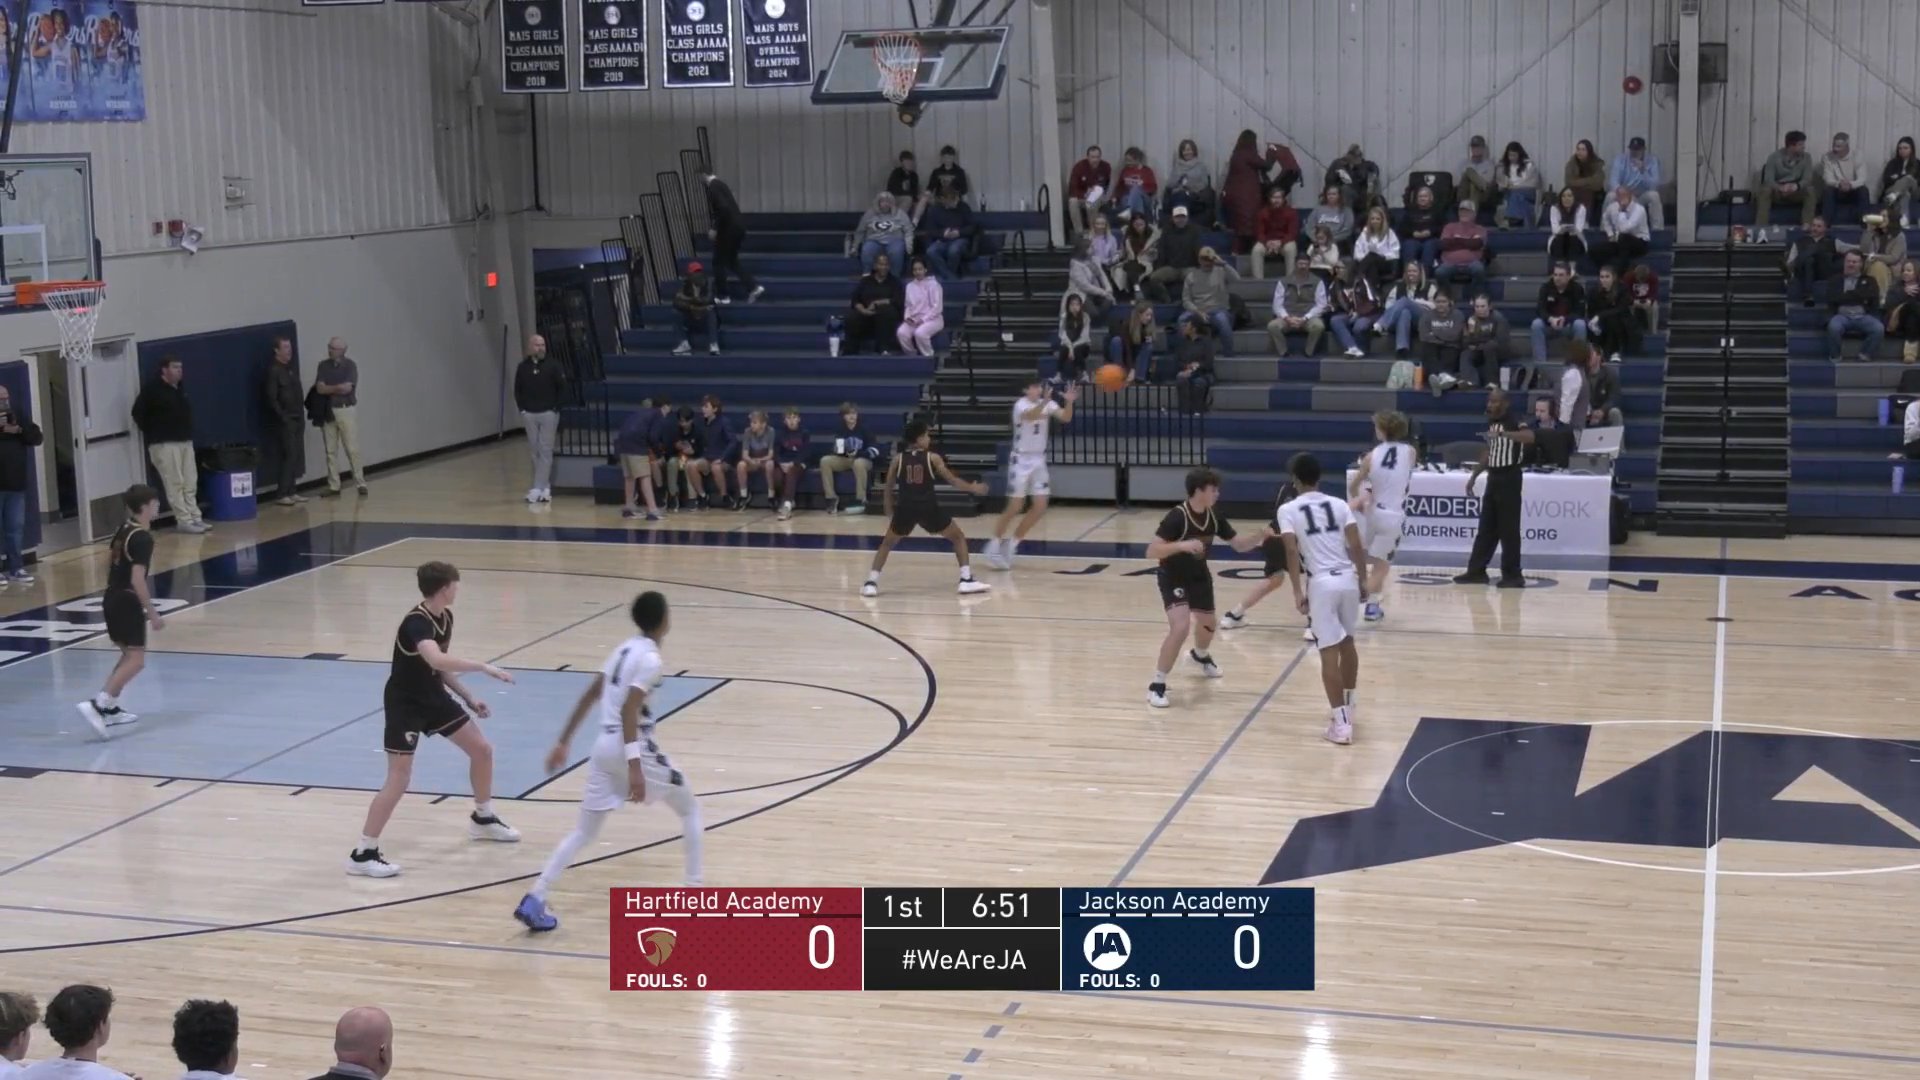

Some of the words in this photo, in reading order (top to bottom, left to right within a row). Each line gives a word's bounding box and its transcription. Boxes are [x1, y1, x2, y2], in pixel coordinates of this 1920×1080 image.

[670, 25, 693, 35] MAIS
[695, 24, 724, 34] GIRLS
[778, 23, 799, 32] BOYS
[509, 31, 530, 41] MAIS
[533, 30, 559, 41] GIRLS
[611, 28, 638, 39] GIRLS
[667, 39, 695, 49] CLASS
[746, 36, 771, 45] CLASS
[505, 46, 530, 57] CLASS
[584, 44, 609, 54] CLASS
[759, 46, 796, 56] OVERALL
[588, 57, 639, 68] CHAMPIONS
[671, 52, 724, 63] CHAMPIONS
[754, 57, 800, 67] CHAMPIONS
[510, 61, 560, 72] CHAMPIONS
[688, 66, 709, 77] 2021
[769, 69, 788, 78] 2024
[1381, 446, 1397, 470] 4
[906, 464, 924, 485] 10
[1299, 501, 1340, 535] 11
